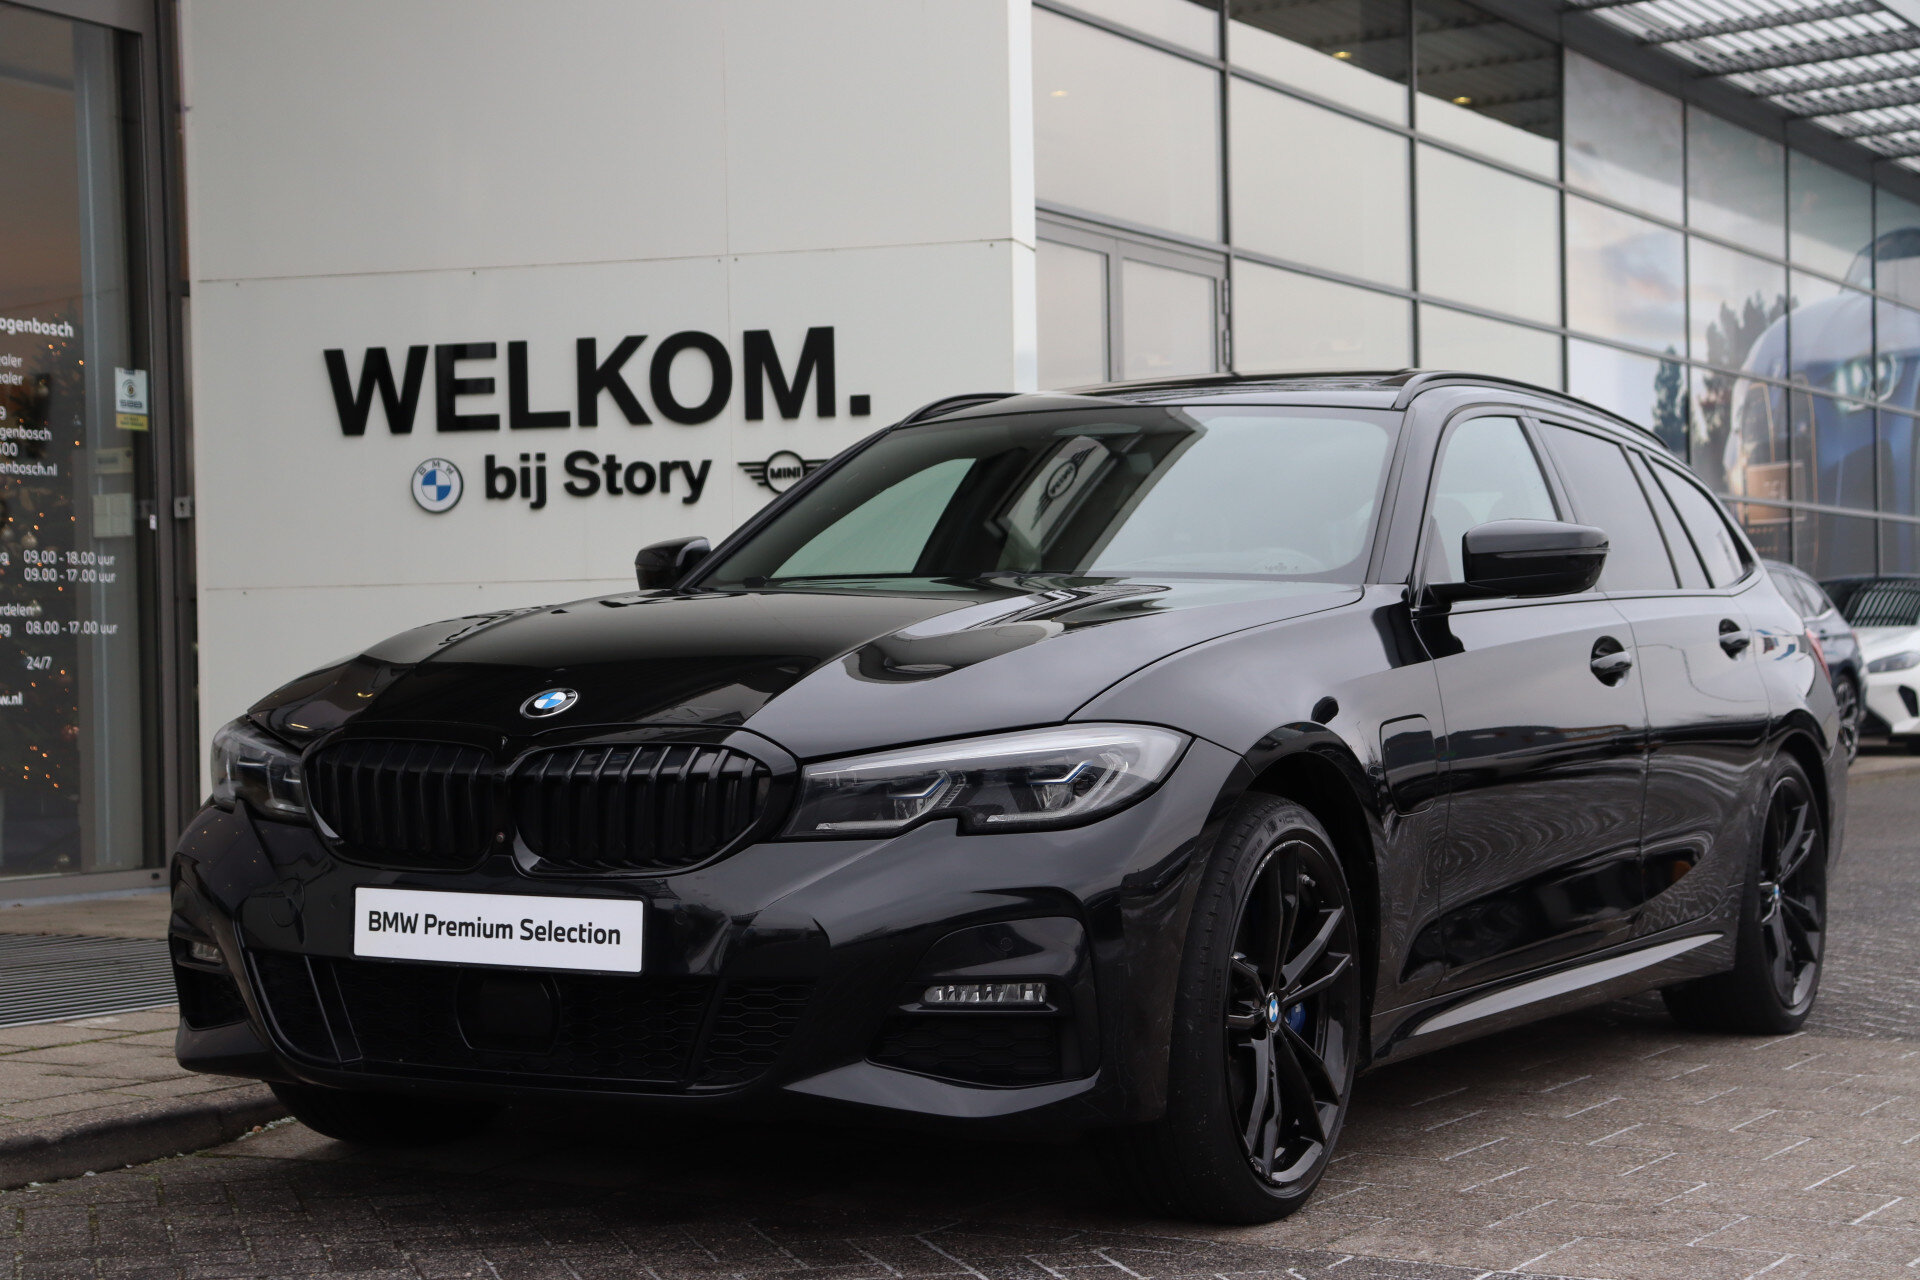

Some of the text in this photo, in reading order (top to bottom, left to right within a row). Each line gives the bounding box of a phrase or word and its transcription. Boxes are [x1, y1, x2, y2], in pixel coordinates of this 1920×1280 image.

[323, 326, 871, 436] WELKOM.
[418, 460, 454, 476] BMW
[769, 467, 801, 479] MINI
[484, 451, 712, 509] bij Story
[23, 550, 57, 564] 09.00
[66, 551, 95, 566] 18.00
[97, 554, 115, 565] uur
[24, 568, 57, 582] 09.00
[67, 569, 97, 583] 17.00
[98, 572, 116, 583] uur
[25, 621, 60, 635] 08.00
[68, 621, 98, 635] 17.00
[100, 623, 118, 635] uur
[26, 656, 52, 670] 24/7
[368, 911, 621, 945] BMW Premium Selection
